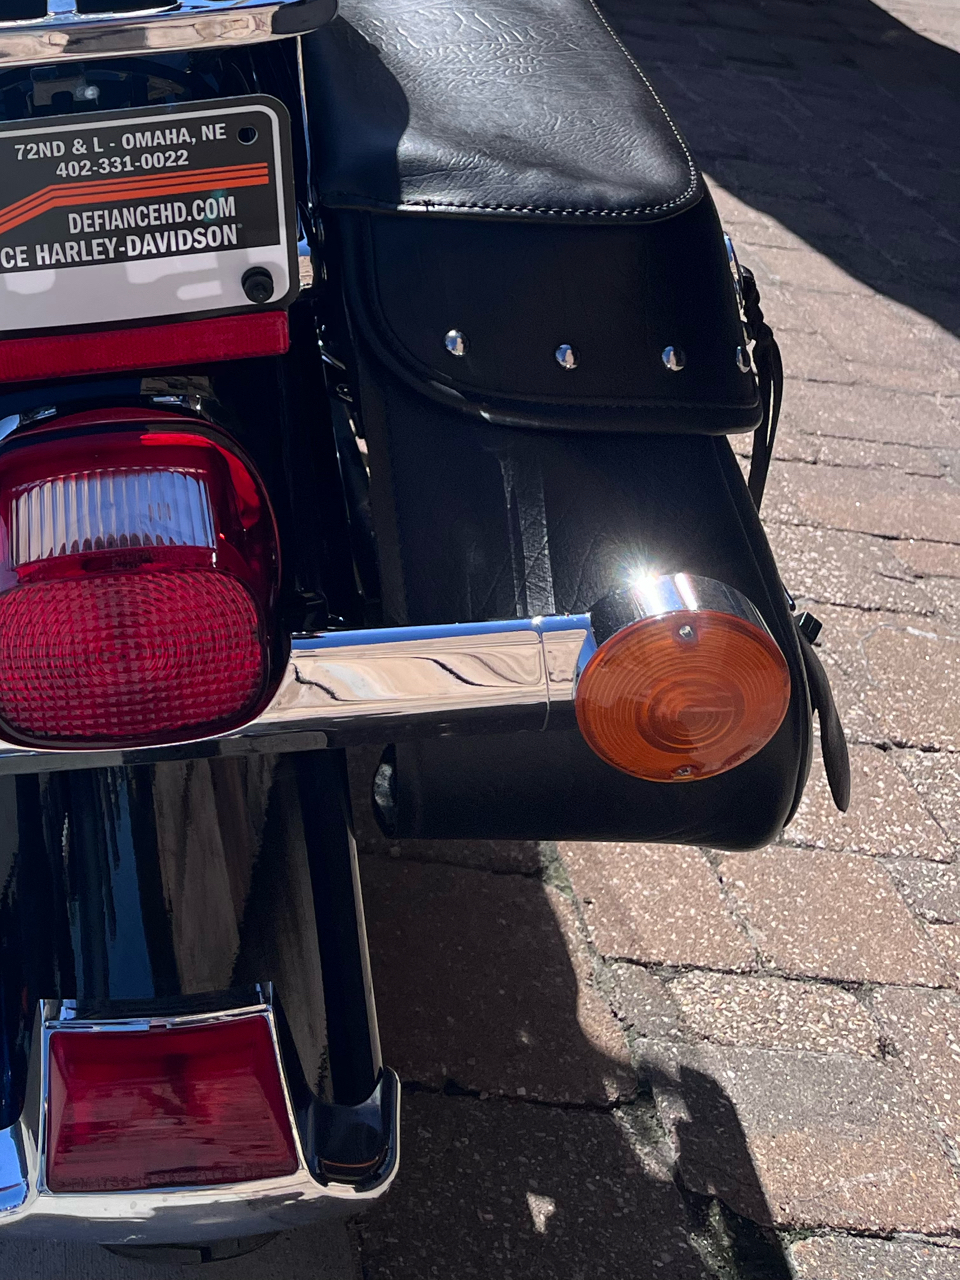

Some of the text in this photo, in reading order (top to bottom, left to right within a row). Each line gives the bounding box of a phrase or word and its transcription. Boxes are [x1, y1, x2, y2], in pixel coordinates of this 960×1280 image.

[14, 140, 66, 161] 72ND
[71, 138, 88, 155] &
[92, 136, 104, 153] L
[121, 127, 197, 150] OMAHA,
[201, 123, 227, 141] NE
[55, 149, 190, 179] 402-331-0022
[68, 195, 237, 235] DEFIANCEHD.COM
[35, 223, 239, 266] HARLEY-DAVIDSON
